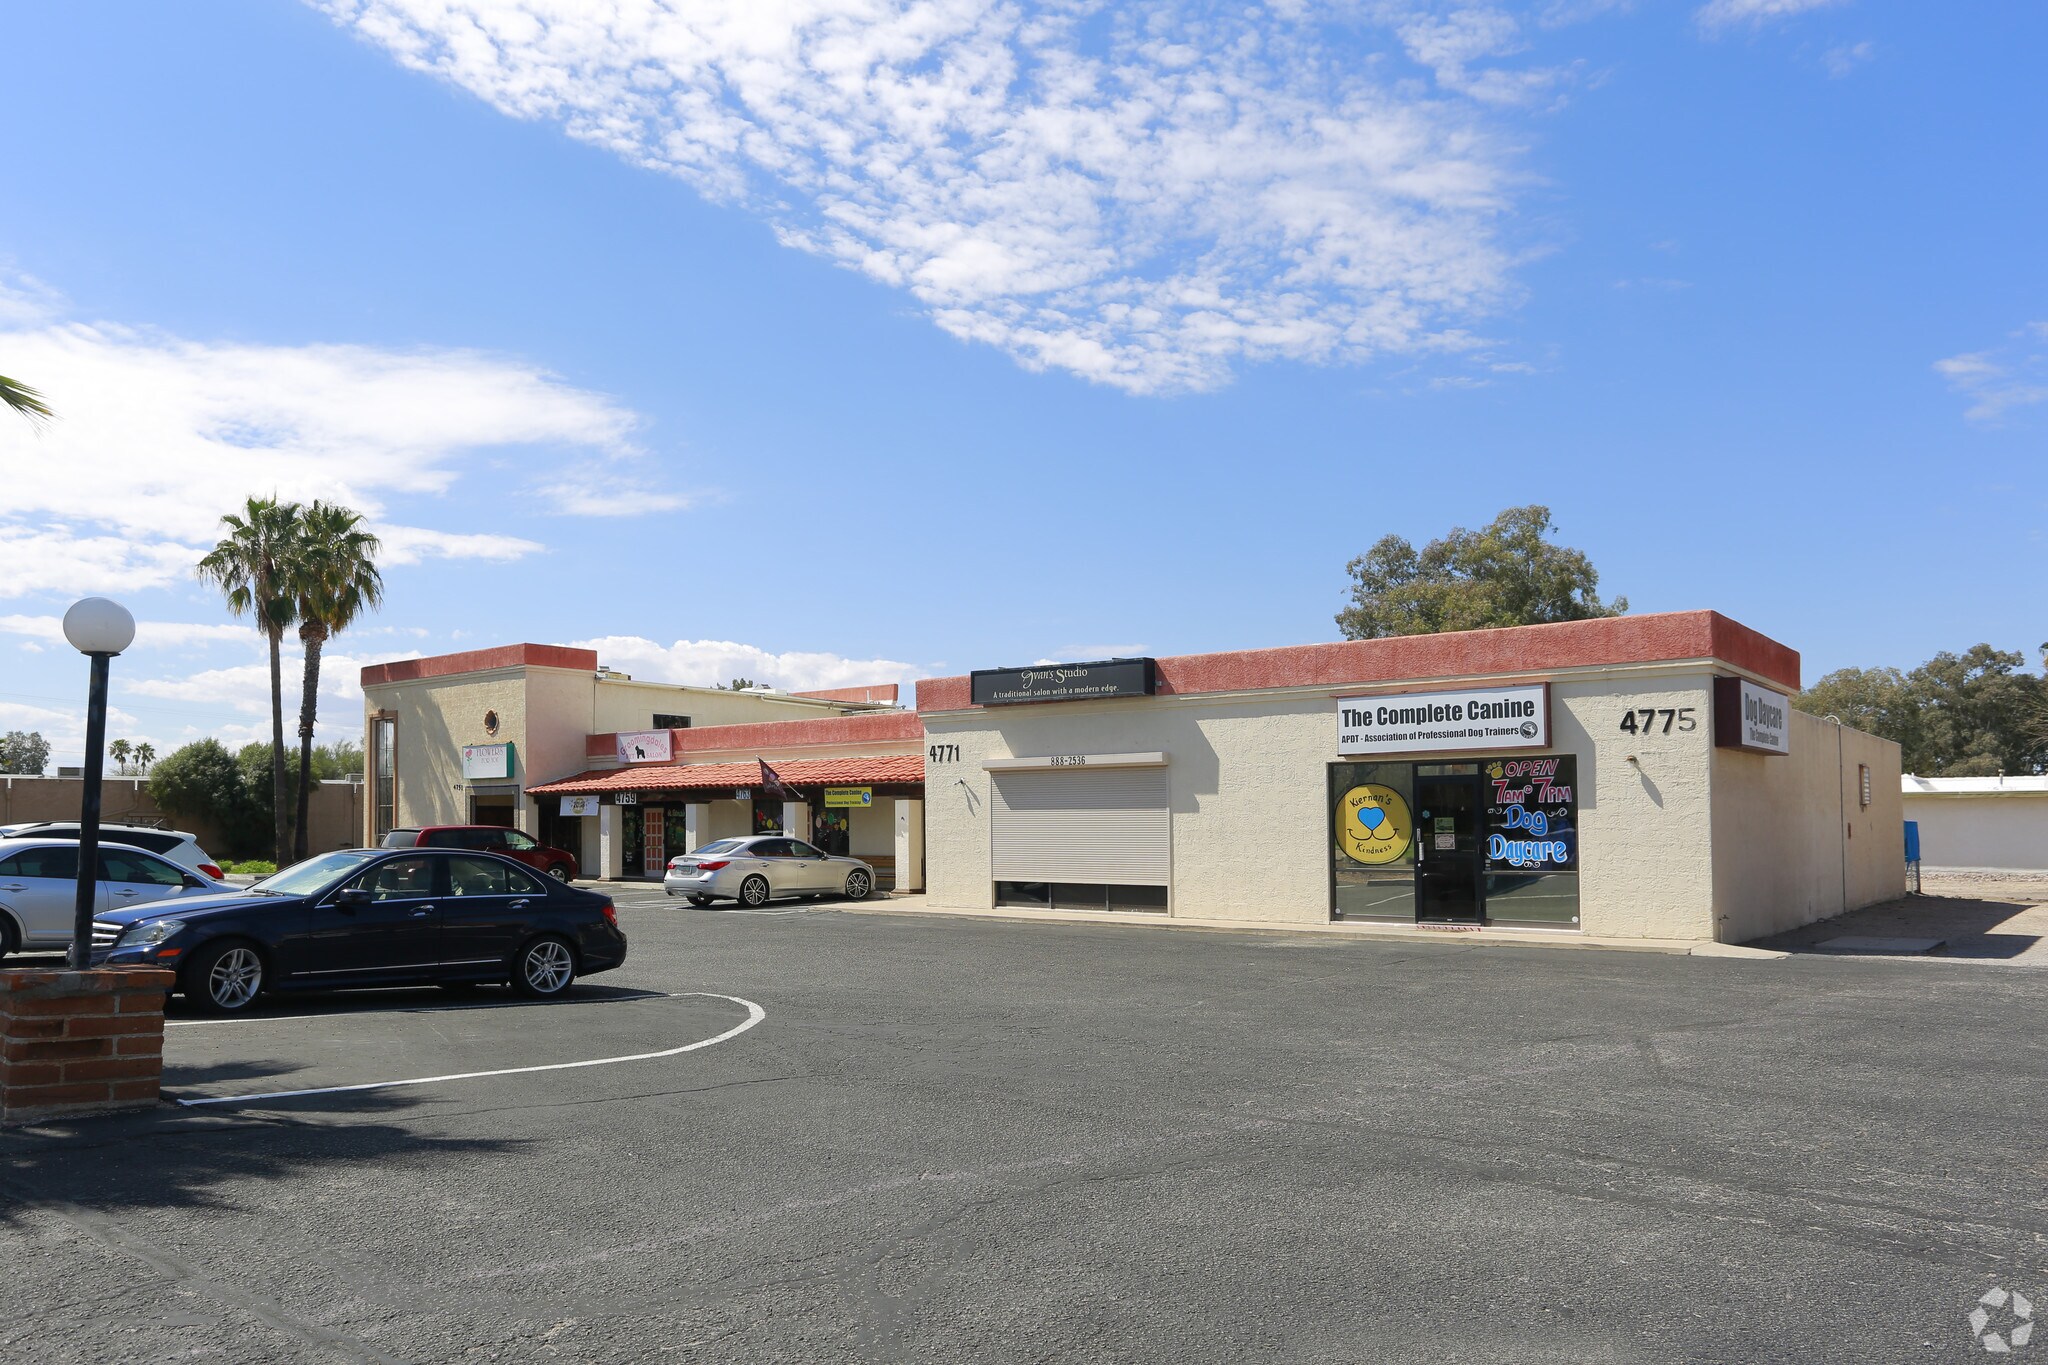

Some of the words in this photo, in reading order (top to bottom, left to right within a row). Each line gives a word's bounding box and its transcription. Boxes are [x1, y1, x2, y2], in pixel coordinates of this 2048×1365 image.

[1055, 666, 1088, 684] Studio
[993, 691, 998, 699] A
[999, 689, 1032, 698] traditional
[1033, 688, 1050, 696] salon
[1052, 687, 1067, 695] with
[1074, 685, 1099, 694] modern
[1101, 684, 1119, 693] edge.
[1342, 709, 1373, 727] The
[1377, 704, 1463, 725] Complete
[1467, 699, 1535, 720] Canine
[1745, 692, 1758, 727] Dog
[1758, 697, 1783, 730] Daycare
[1620, 708, 1697, 735] 4775
[1341, 735, 1359, 743] APDT
[1364, 732, 1408, 742] Association
[1409, 732, 1416, 740] of
[1418, 729, 1466, 740] Professional
[1468, 728, 1483, 737] Dog
[1485, 727, 1519, 736] Trainers
[620, 735, 668, 756] Groomingdales
[929, 745, 960, 762] 4771
[1051, 756, 1086, 765] 888-2536
[1505, 759, 1560, 777] OPEN
[615, 792, 635, 803] 4759
[1492, 779, 1525, 804] 7AM
[1532, 776, 1573, 803] 7PM
[1350, 794, 1392, 808] Kiernan's
[1501, 804, 1548, 836] Dog
[1356, 842, 1392, 854] Kindness
[1487, 834, 1568, 866] Daycare
